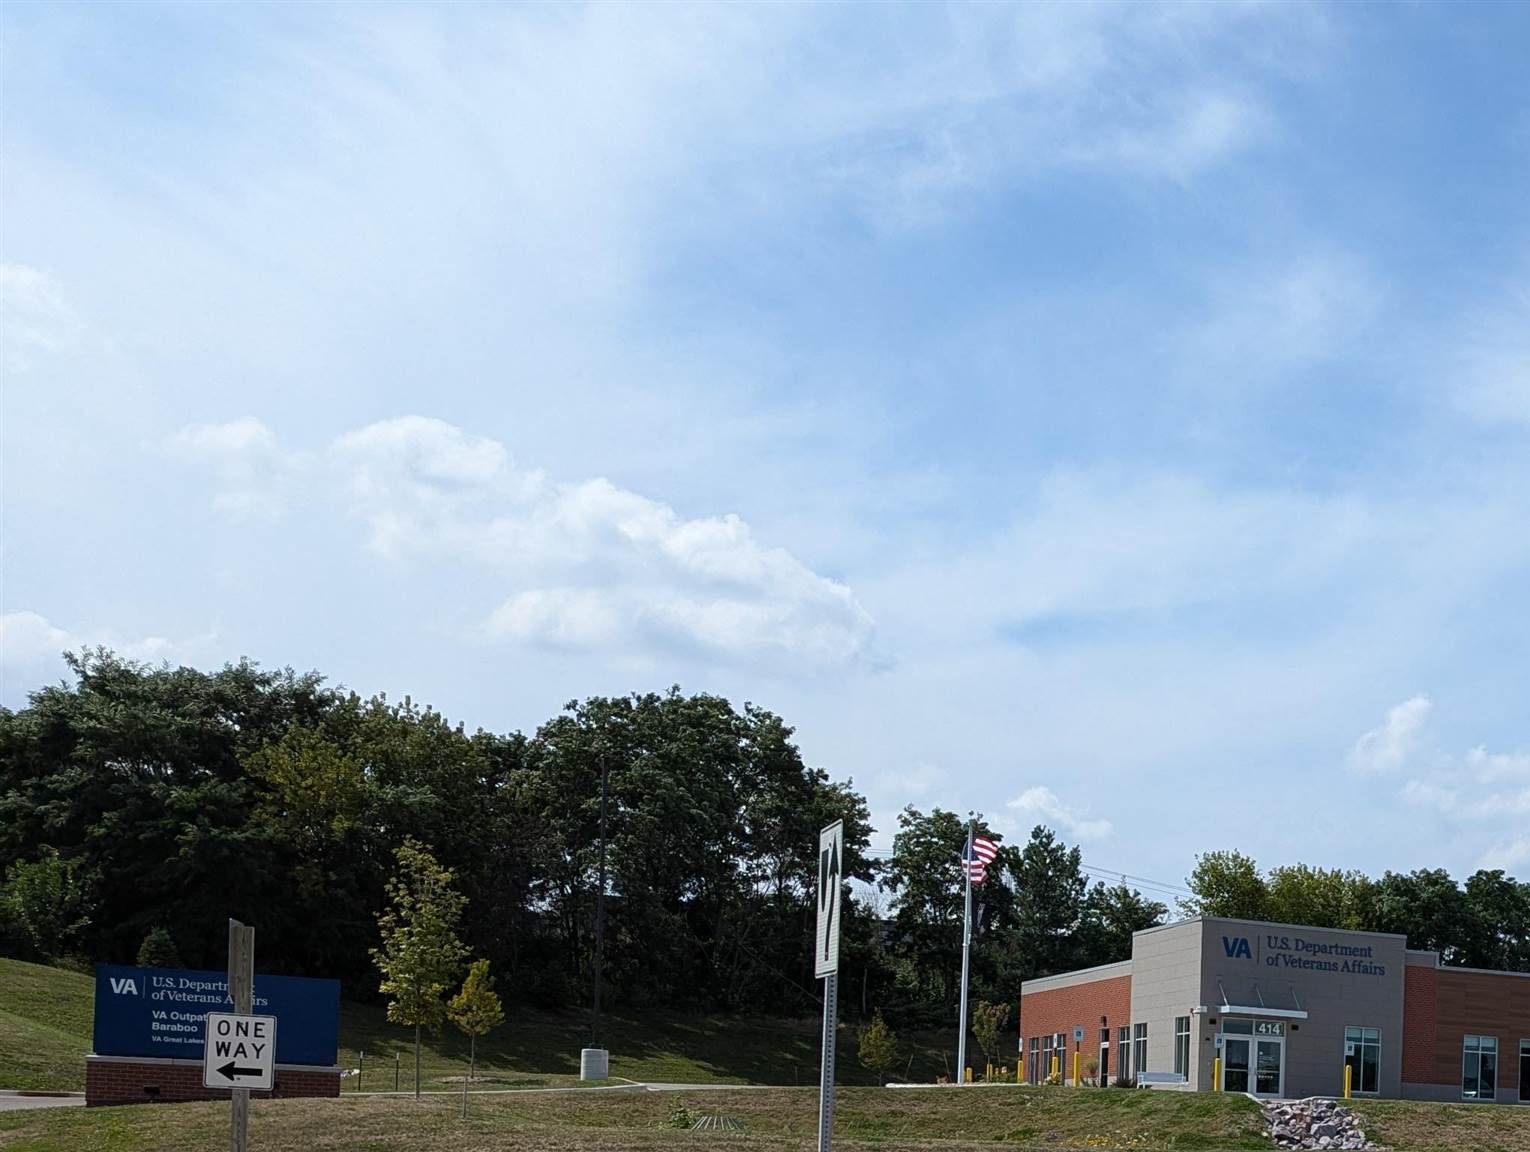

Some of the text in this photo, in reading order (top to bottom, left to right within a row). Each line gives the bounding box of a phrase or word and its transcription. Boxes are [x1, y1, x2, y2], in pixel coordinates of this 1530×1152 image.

[1222, 935, 1252, 959] VA
[1266, 935, 1373, 958] U.S. Department
[1266, 954, 1386, 976] of Veterans Affairs
[110, 977, 138, 995] VA
[152, 976, 255, 992] U.S. Depart
[151, 989, 268, 1006] of Veterans Airs
[152, 1010, 208, 1023] VA Outpat
[151, 1022, 198, 1032] Baraboo
[217, 1020, 266, 1038] ONE
[1258, 1023, 1280, 1035] 414
[215, 1040, 266, 1059] WAY
